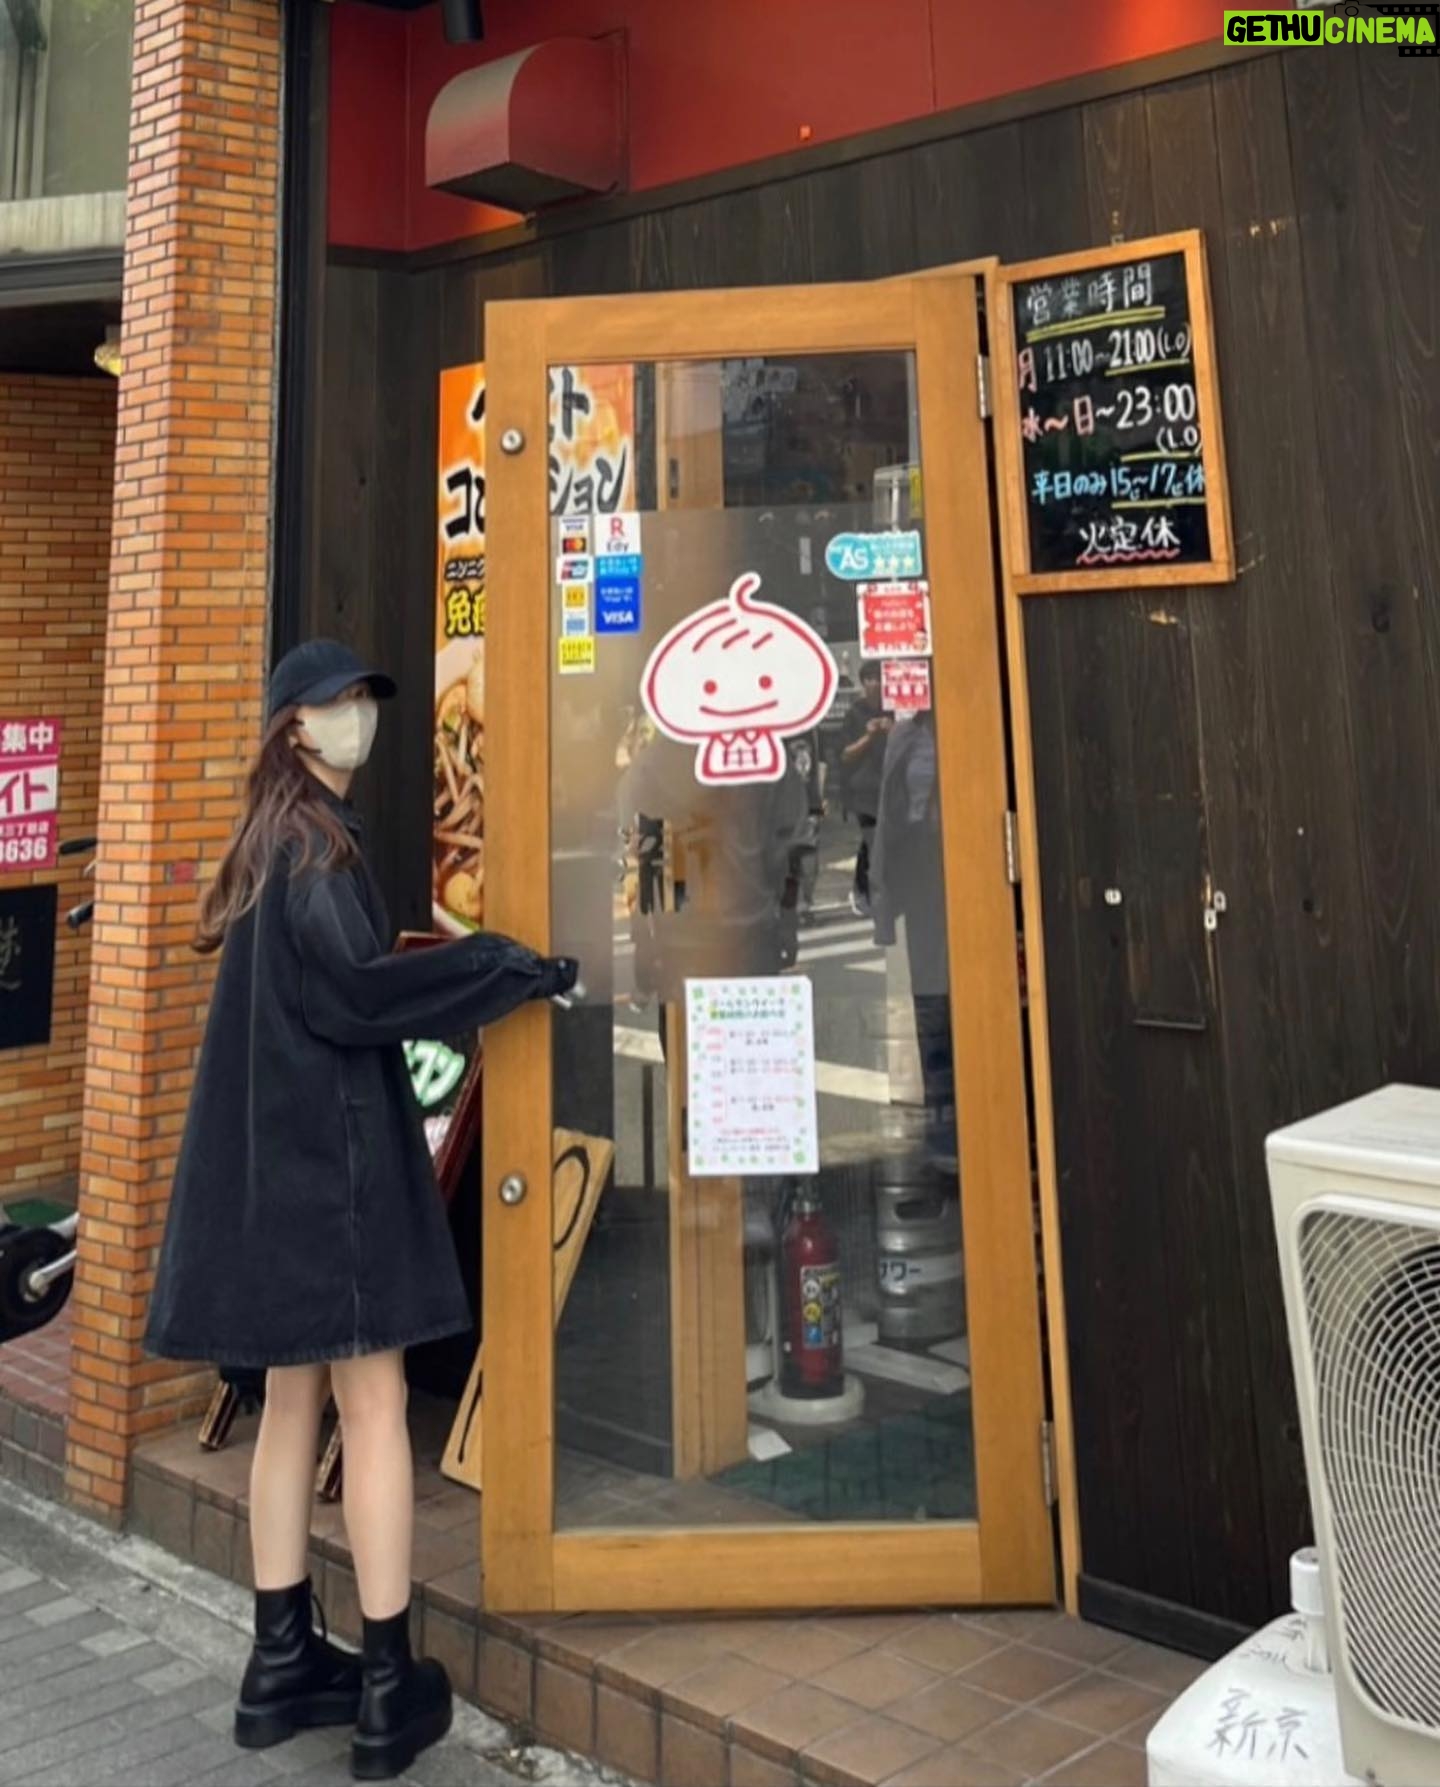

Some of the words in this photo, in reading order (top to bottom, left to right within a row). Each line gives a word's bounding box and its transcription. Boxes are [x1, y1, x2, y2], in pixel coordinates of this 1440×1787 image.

[1027, 262, 1152, 326] 営業時間
[1079, 515, 1181, 556] 火定休
[602, 611, 634, 624] VISA
[0, 837, 48, 864] 636
